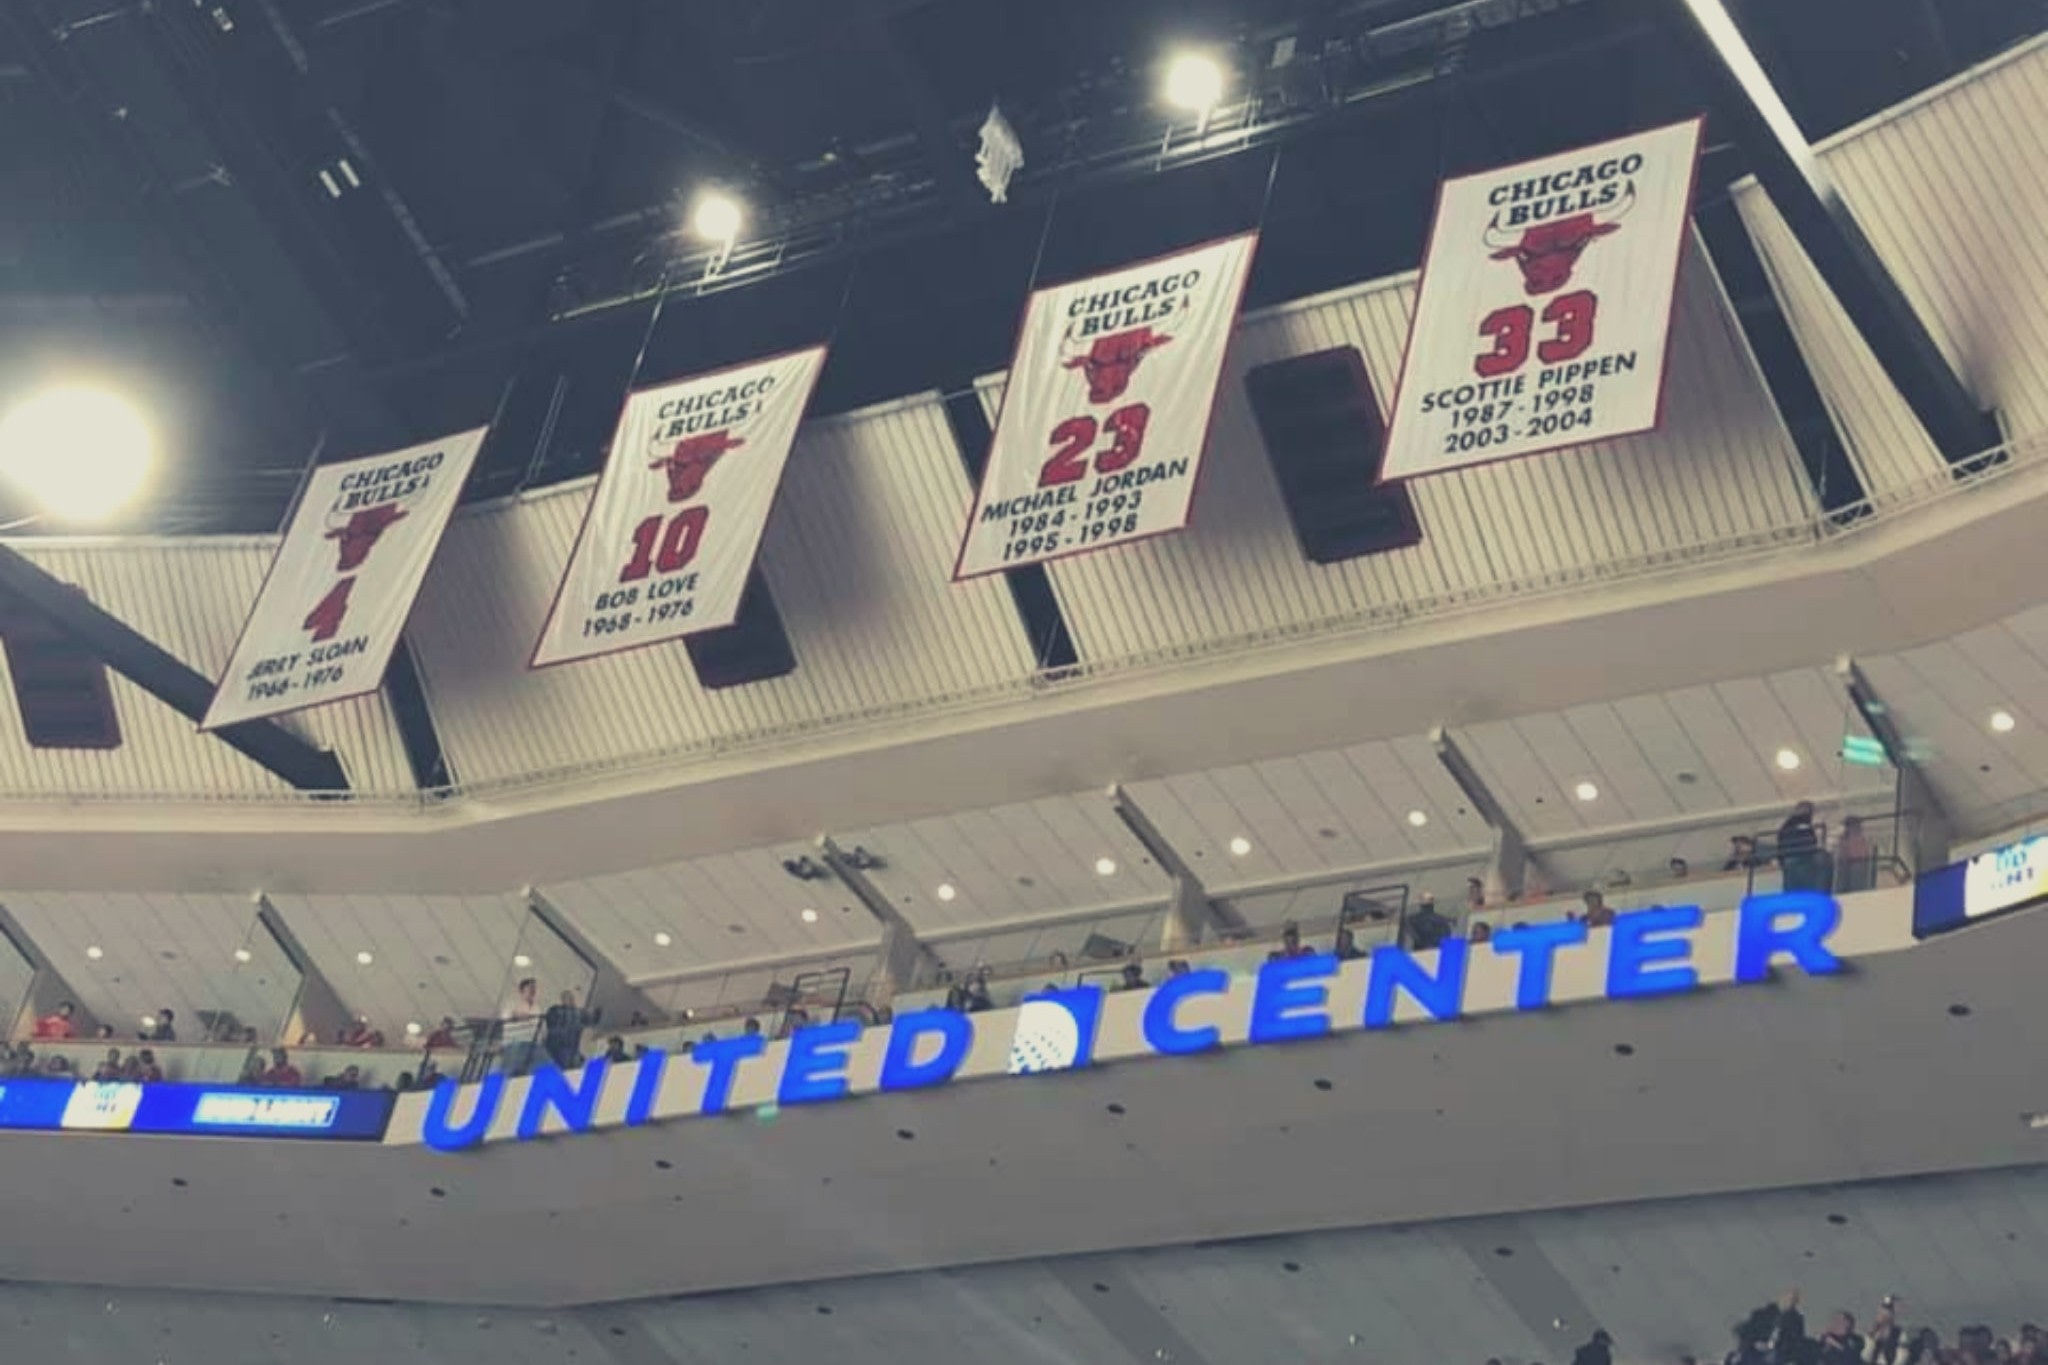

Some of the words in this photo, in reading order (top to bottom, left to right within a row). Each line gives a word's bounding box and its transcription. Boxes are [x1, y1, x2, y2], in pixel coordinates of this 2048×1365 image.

[1488, 153, 1644, 206] CHICAGO
[1506, 183, 1618, 227] BULLS
[1068, 269, 1201, 318] CHICAGO
[1080, 296, 1176, 337] BULLS
[1474, 290, 1598, 378] 33
[658, 376, 775, 421] CHICAGO
[1421, 374, 1526, 413] SCOTTIE
[1538, 351, 1637, 388] PIPPEN
[665, 403, 751, 439] BULLS
[1038, 402, 1151, 488] 23
[340, 452, 444, 491] CHICAGO
[343, 477, 420, 510] BULLS
[981, 486, 1077, 522] MICHAEL
[1091, 457, 1188, 497] JORDAN
[619, 506, 709, 583] 10
[302, 575, 356, 643] 4
[595, 588, 638, 611] BOB
[647, 573, 699, 600] LOVE
[421, 1008, 974, 1152] UNITED
[1143, 889, 1842, 1056] CENTER
